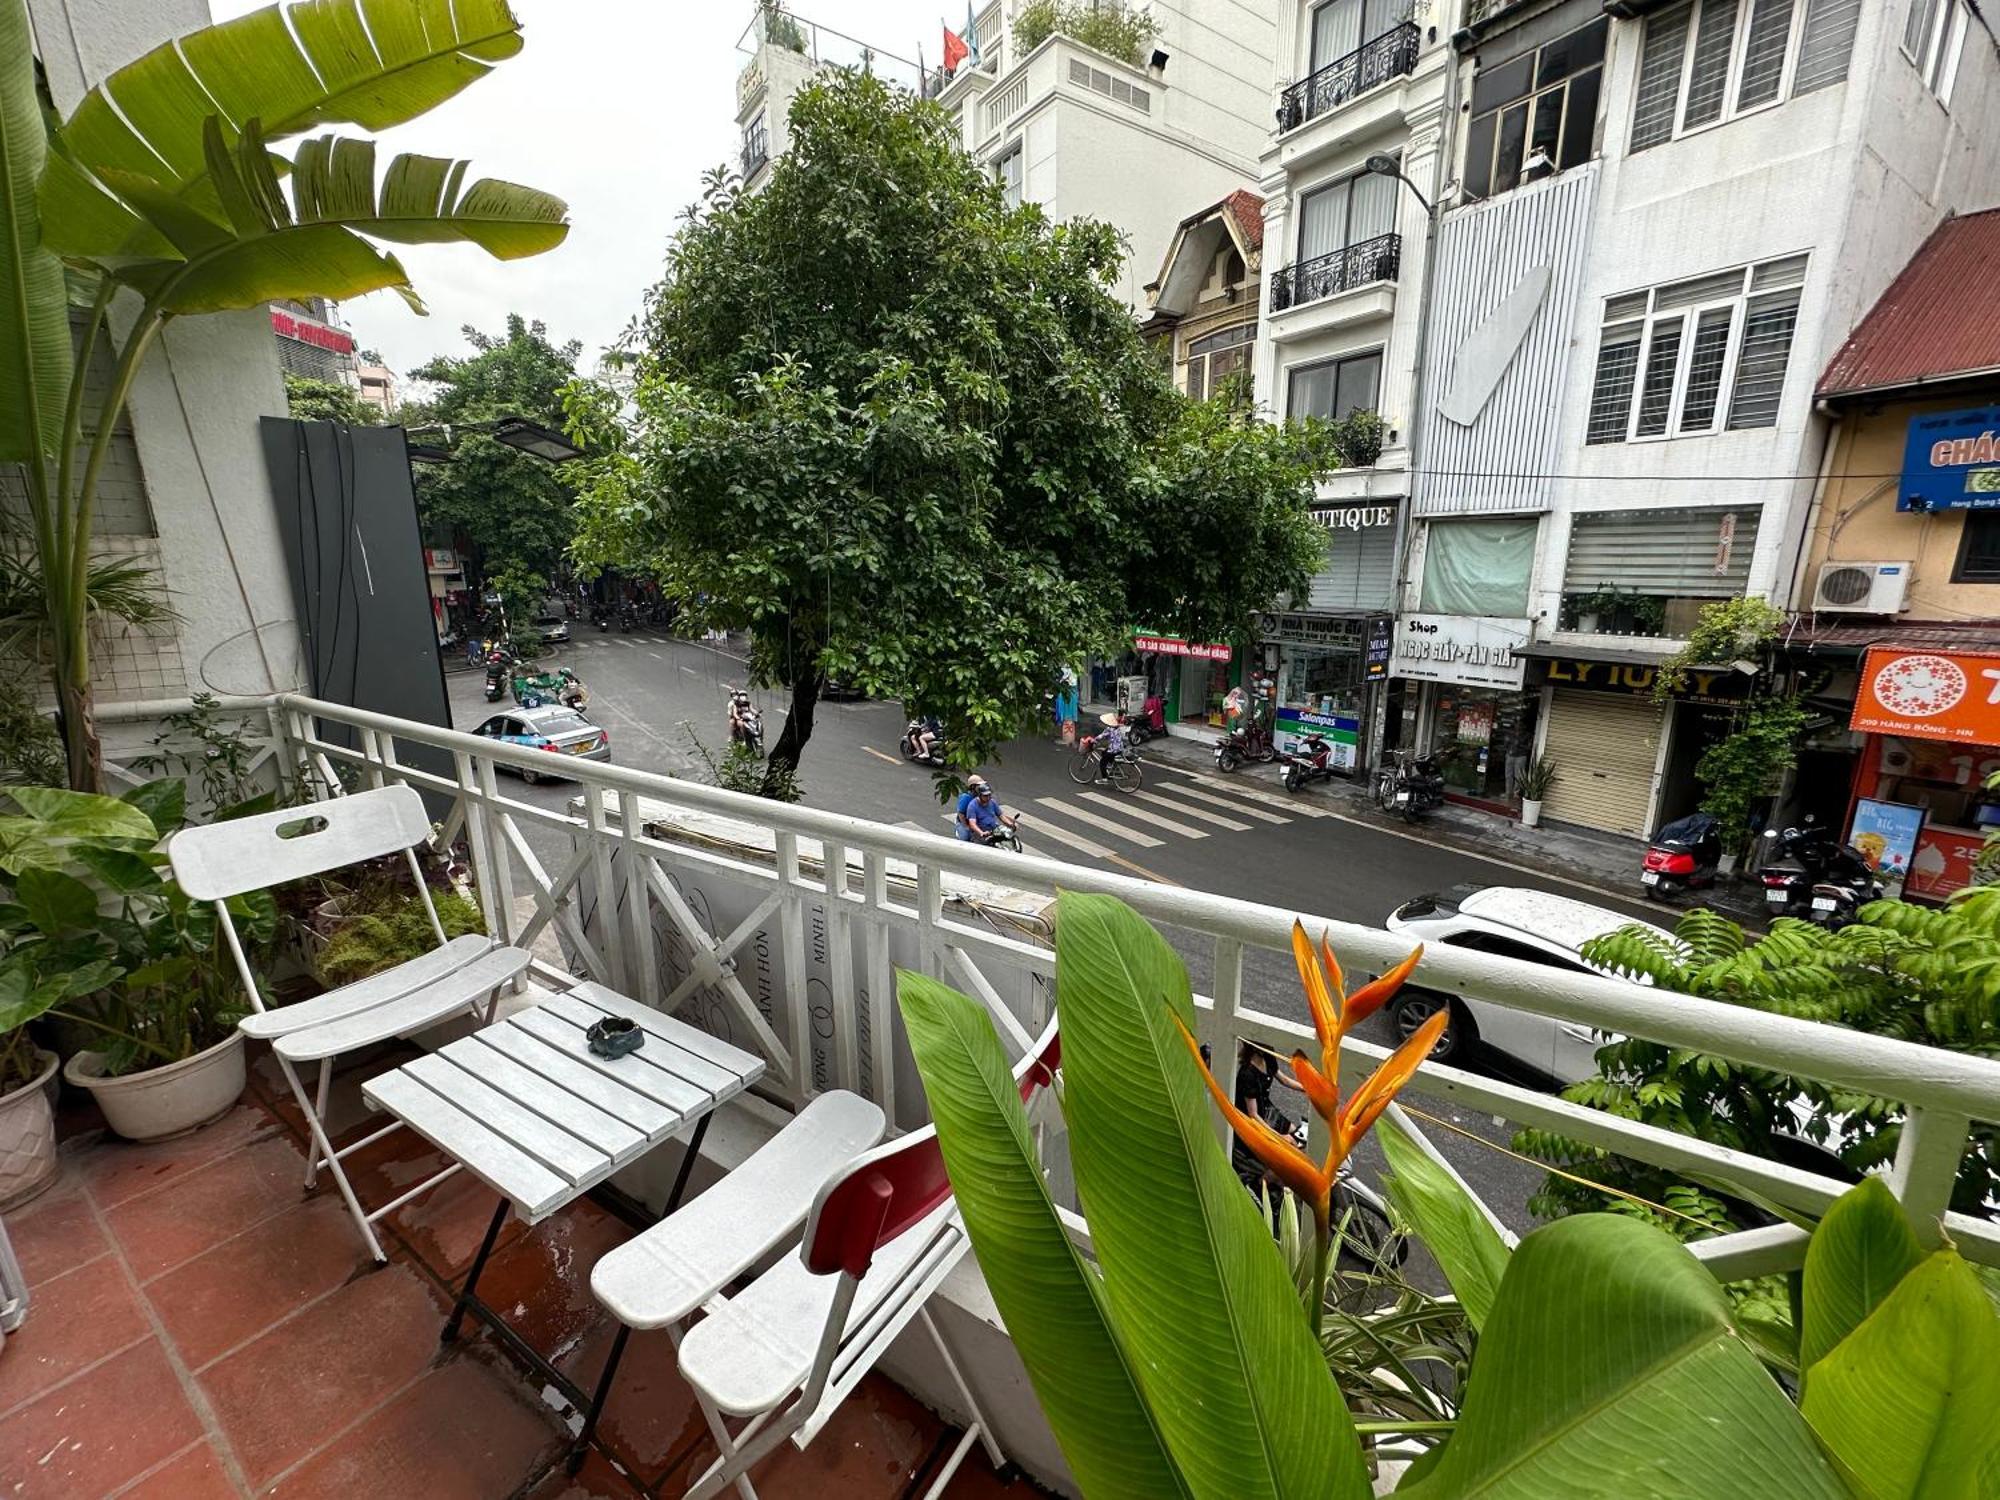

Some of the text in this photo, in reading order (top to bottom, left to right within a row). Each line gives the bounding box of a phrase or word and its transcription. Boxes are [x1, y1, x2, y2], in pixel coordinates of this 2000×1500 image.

[1309, 506, 1391, 531] UTIQUE
[1409, 620, 1438, 635] Shop
[1298, 711, 1336, 727] Salonpas
[812, 922, 825, 964] MINH
